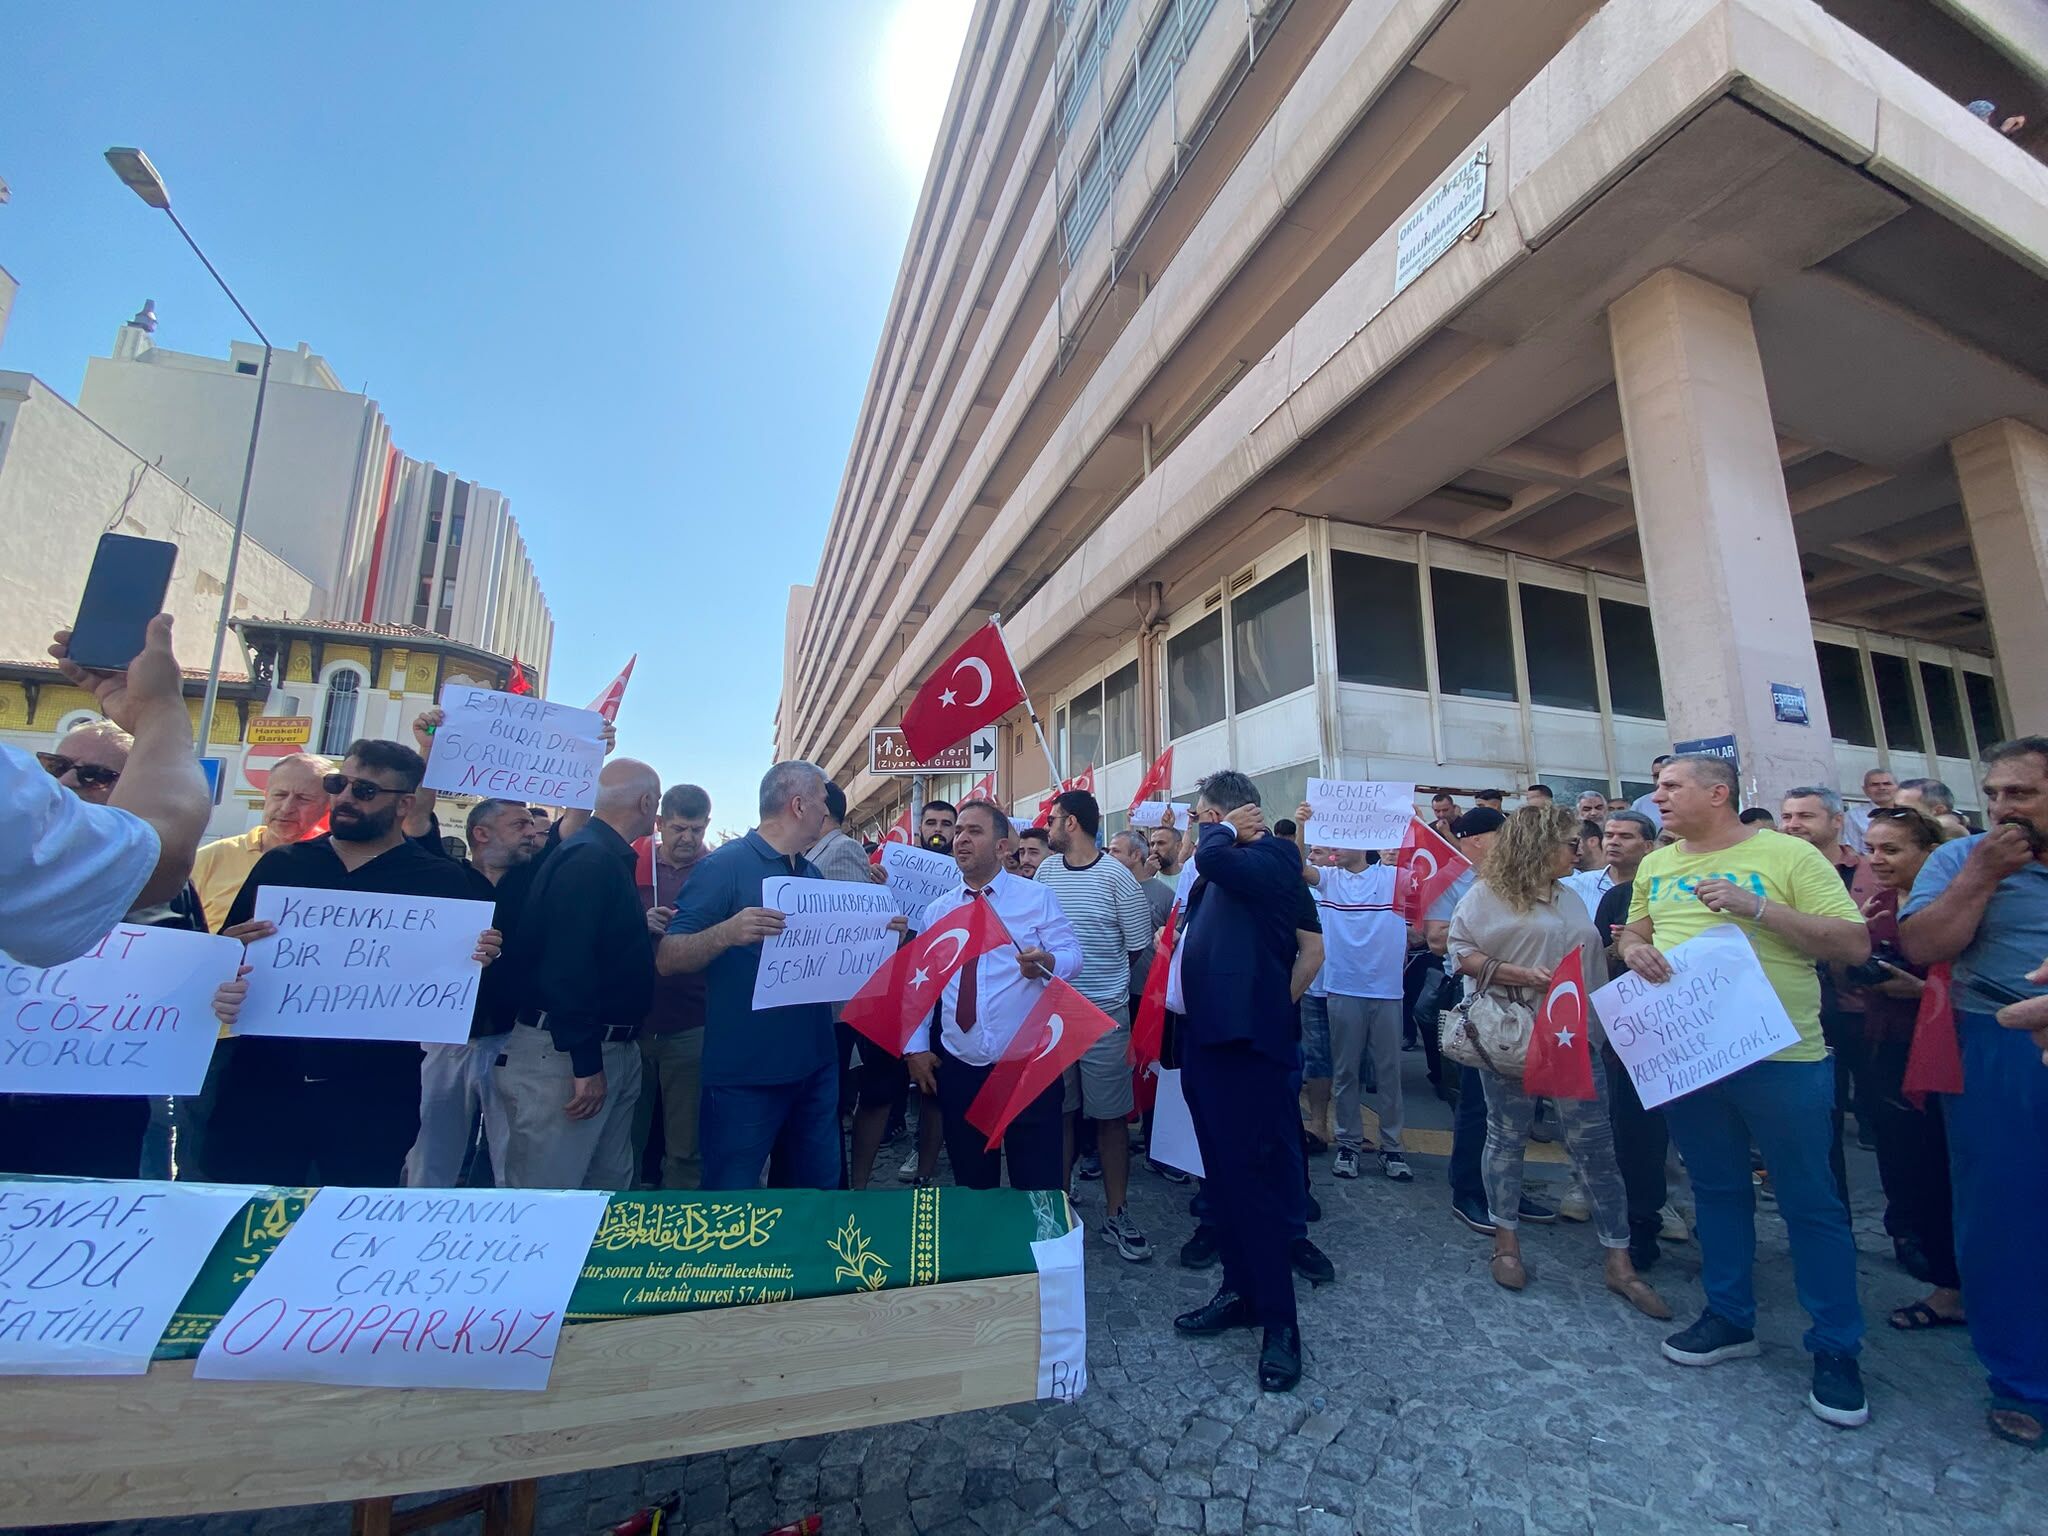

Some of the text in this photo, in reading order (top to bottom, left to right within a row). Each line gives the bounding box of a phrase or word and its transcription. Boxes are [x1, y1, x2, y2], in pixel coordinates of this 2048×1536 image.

[464, 691, 559, 722] ESNAF
[255, 727, 303, 735] Hareketli
[258, 735, 297, 743] Bariyer
[489, 718, 577, 753] BURADA
[278, 896, 438, 932] KEPENKLER
[272, 937, 392, 969] BİR BİR
[763, 951, 829, 989] SESİNİ
[277, 976, 474, 1015] KAPANIYOR!
[1613, 967, 1731, 1048] SUSARSAK
[1653, 1000, 1716, 1046] YARIN
[1632, 1031, 1715, 1087] KEPENKLER
[337, 1193, 537, 1225] DÜNYANIN
[330, 1230, 550, 1263] EN BÜYÜK
[335, 1265, 509, 1302] ÇARŞISI
[646, 1261, 674, 1279] bize
[693, 1285, 736, 1304] suresi
[221, 1298, 557, 1360] OTOPARKSIZ
